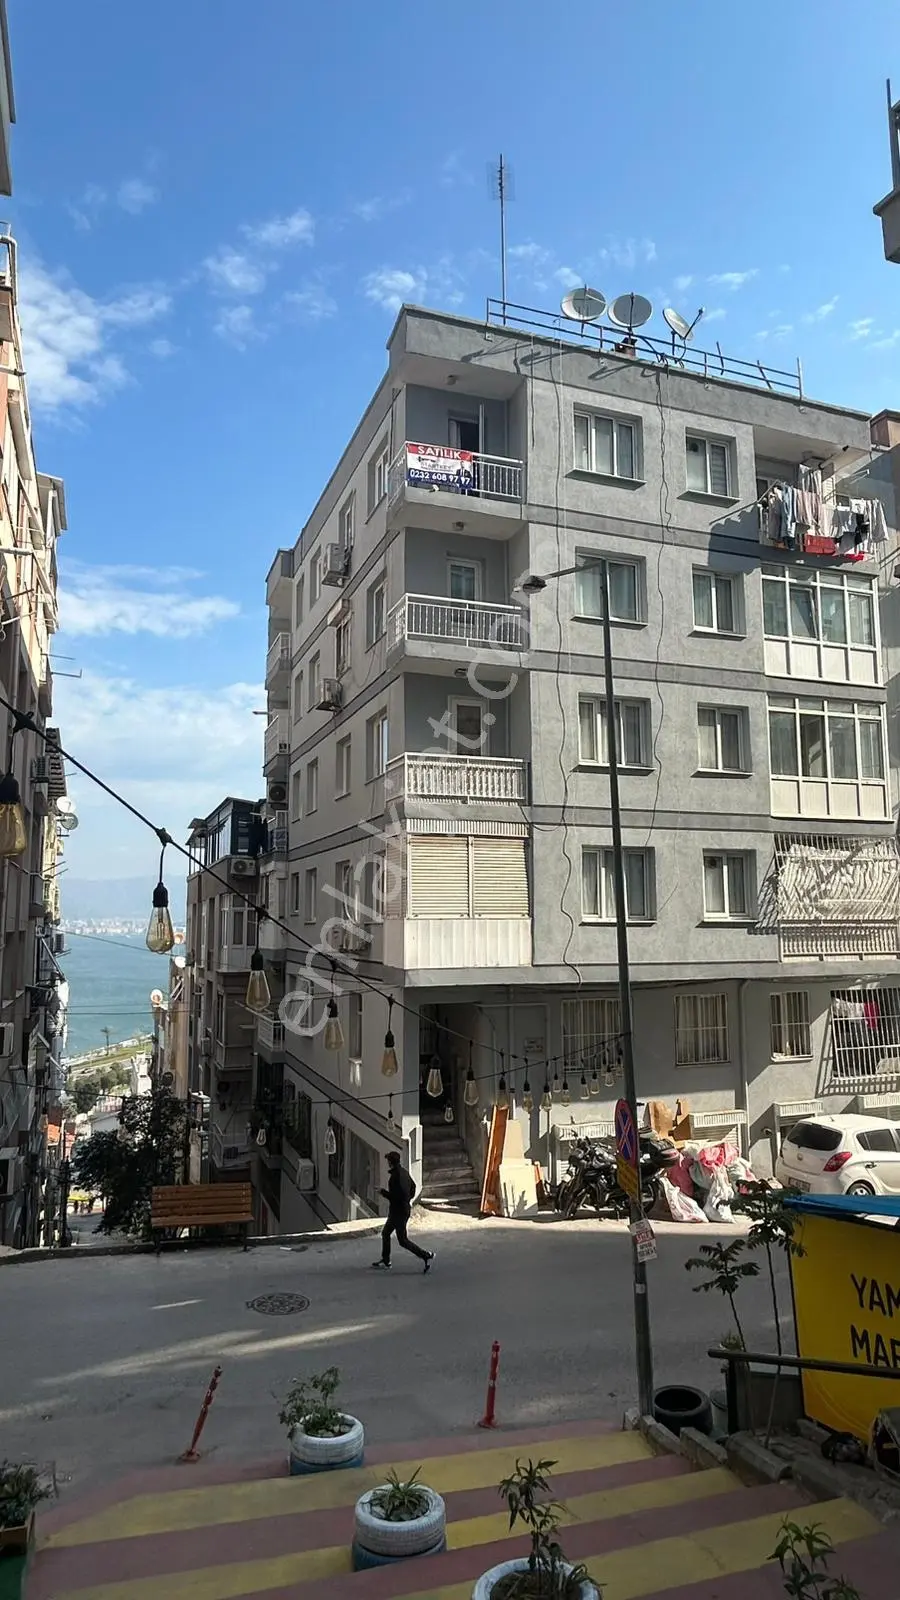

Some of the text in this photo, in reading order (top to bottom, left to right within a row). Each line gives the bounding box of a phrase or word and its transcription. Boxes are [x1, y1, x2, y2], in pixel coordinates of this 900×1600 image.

[417, 446, 461, 460] SATILIK
[410, 469, 430, 479] 0232
[432, 473, 447, 481] 608
[449, 475, 459, 483] 97
